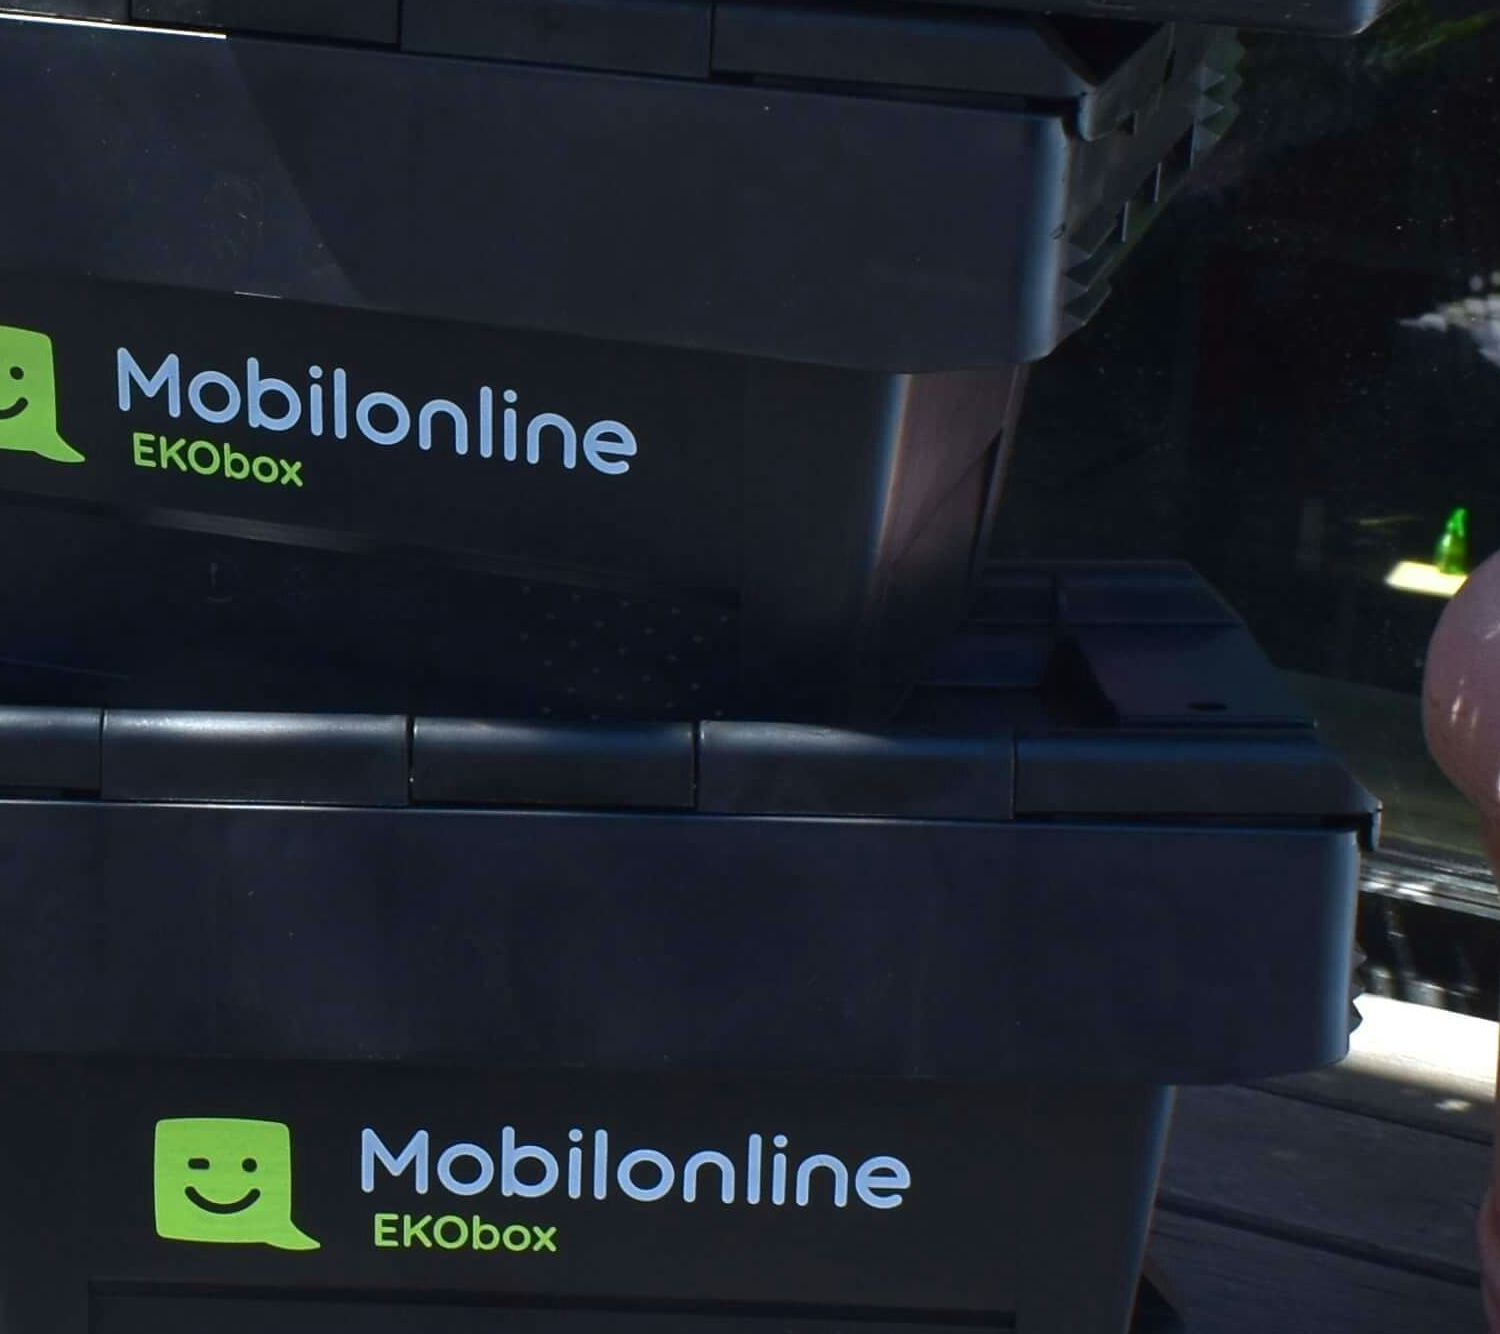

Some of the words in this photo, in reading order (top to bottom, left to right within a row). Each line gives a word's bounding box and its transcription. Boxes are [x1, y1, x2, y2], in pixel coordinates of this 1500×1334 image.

[117, 347, 638, 475] Mobilonline
[132, 431, 304, 487] EKObox
[361, 1124, 911, 1209] Mobilonline
[374, 1212, 558, 1253] EKObox
